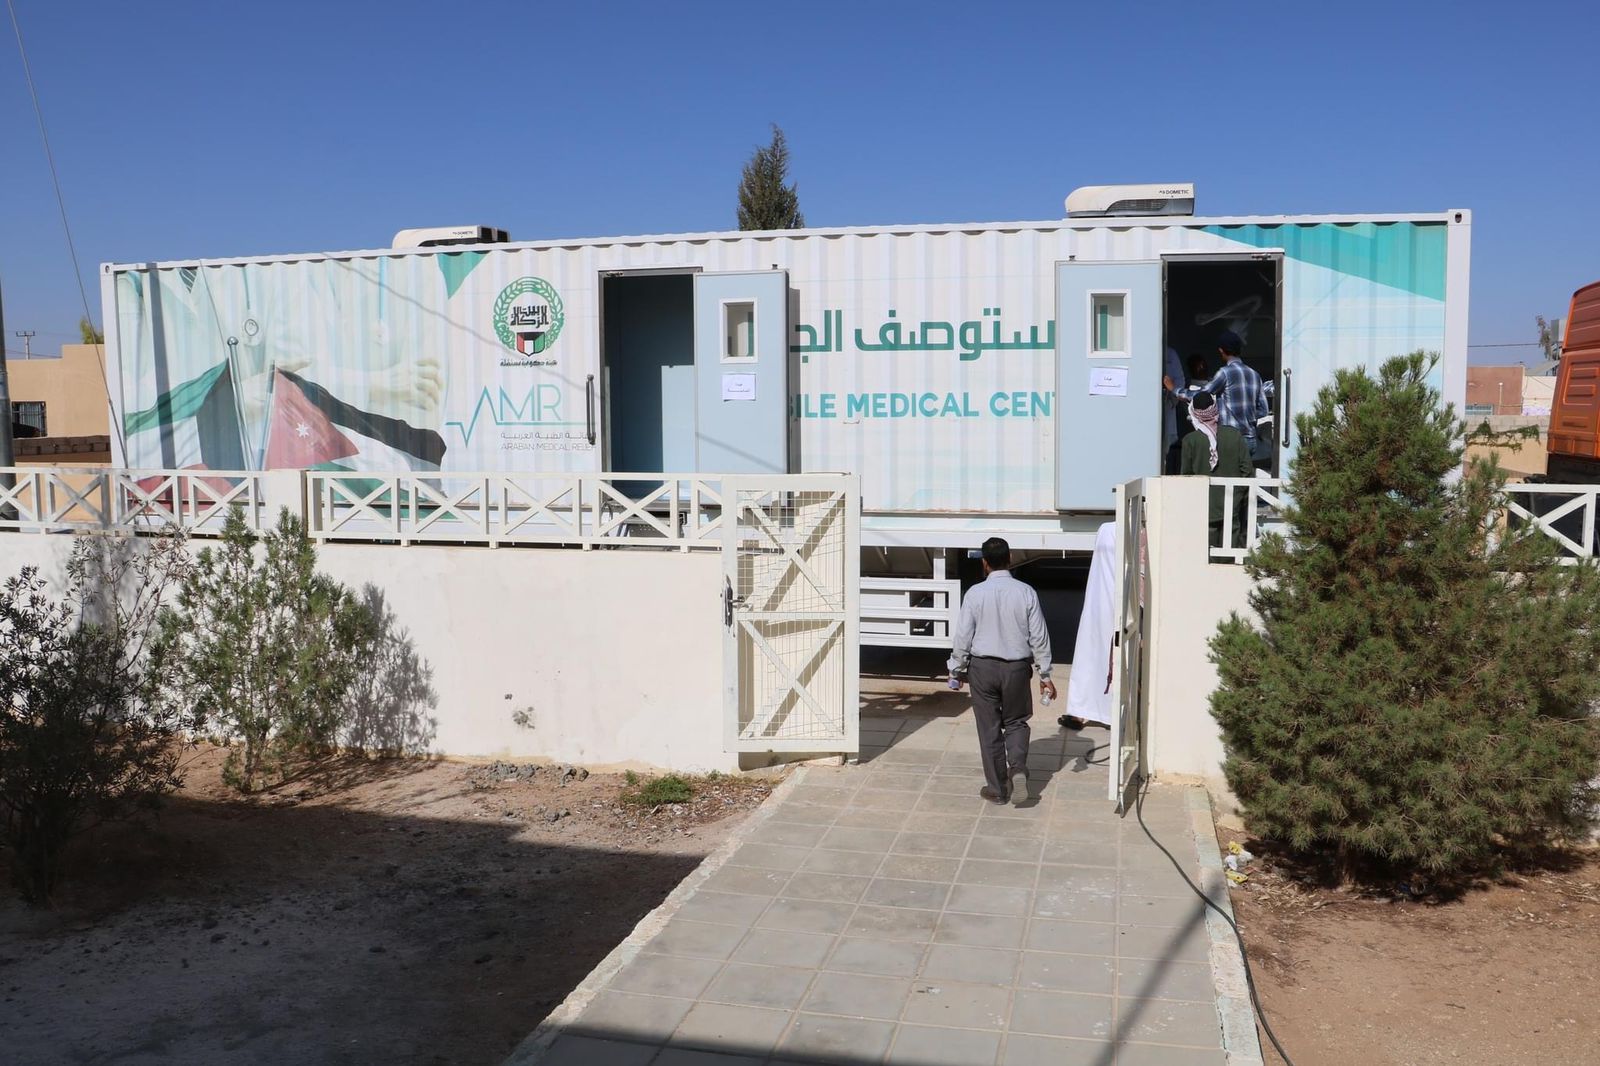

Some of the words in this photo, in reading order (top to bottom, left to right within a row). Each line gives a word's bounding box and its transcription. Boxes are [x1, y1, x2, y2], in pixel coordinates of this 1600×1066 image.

[790, 310, 842, 363] الج
[854, 308, 1055, 361] ستوصف
[790, 393, 837, 418] ILE
[847, 391, 980, 418] MEDICAL
[988, 391, 1056, 417] CEN
